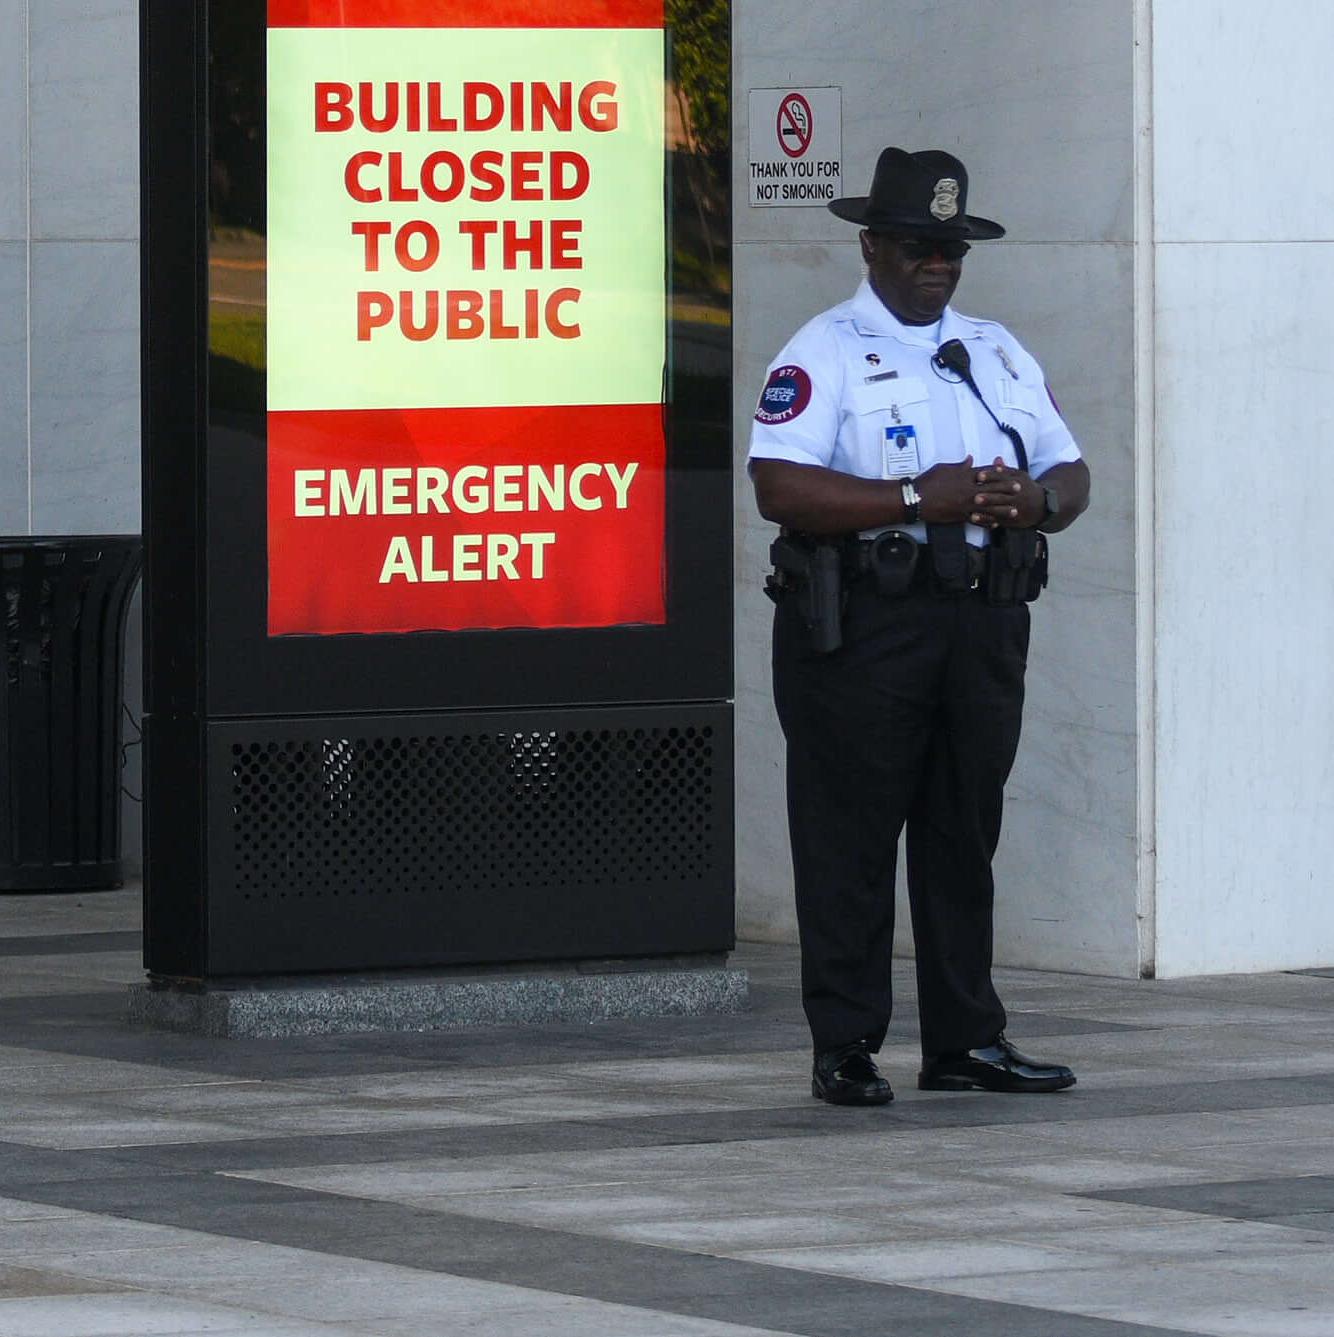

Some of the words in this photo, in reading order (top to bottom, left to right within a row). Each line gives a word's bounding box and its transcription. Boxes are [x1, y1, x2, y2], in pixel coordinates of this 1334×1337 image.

[314, 80, 618, 133] BUILDING
[344, 150, 590, 204] CLOSED
[750, 163, 788, 178] THANK
[790, 162, 814, 177] YOU
[817, 161, 840, 177] FOR
[757, 184, 779, 199] NOT
[782, 184, 834, 199] SMOKING
[351, 220, 440, 272] TO
[458, 219, 583, 271] THE
[357, 287, 581, 342] PUBLIC
[755, 407, 793, 421] SECURITY
[765, 393, 791, 402] POLICE
[766, 387, 795, 396] SPECIAL
[294, 462, 639, 517] EMERGENCY
[378, 532, 556, 584] ALERT
